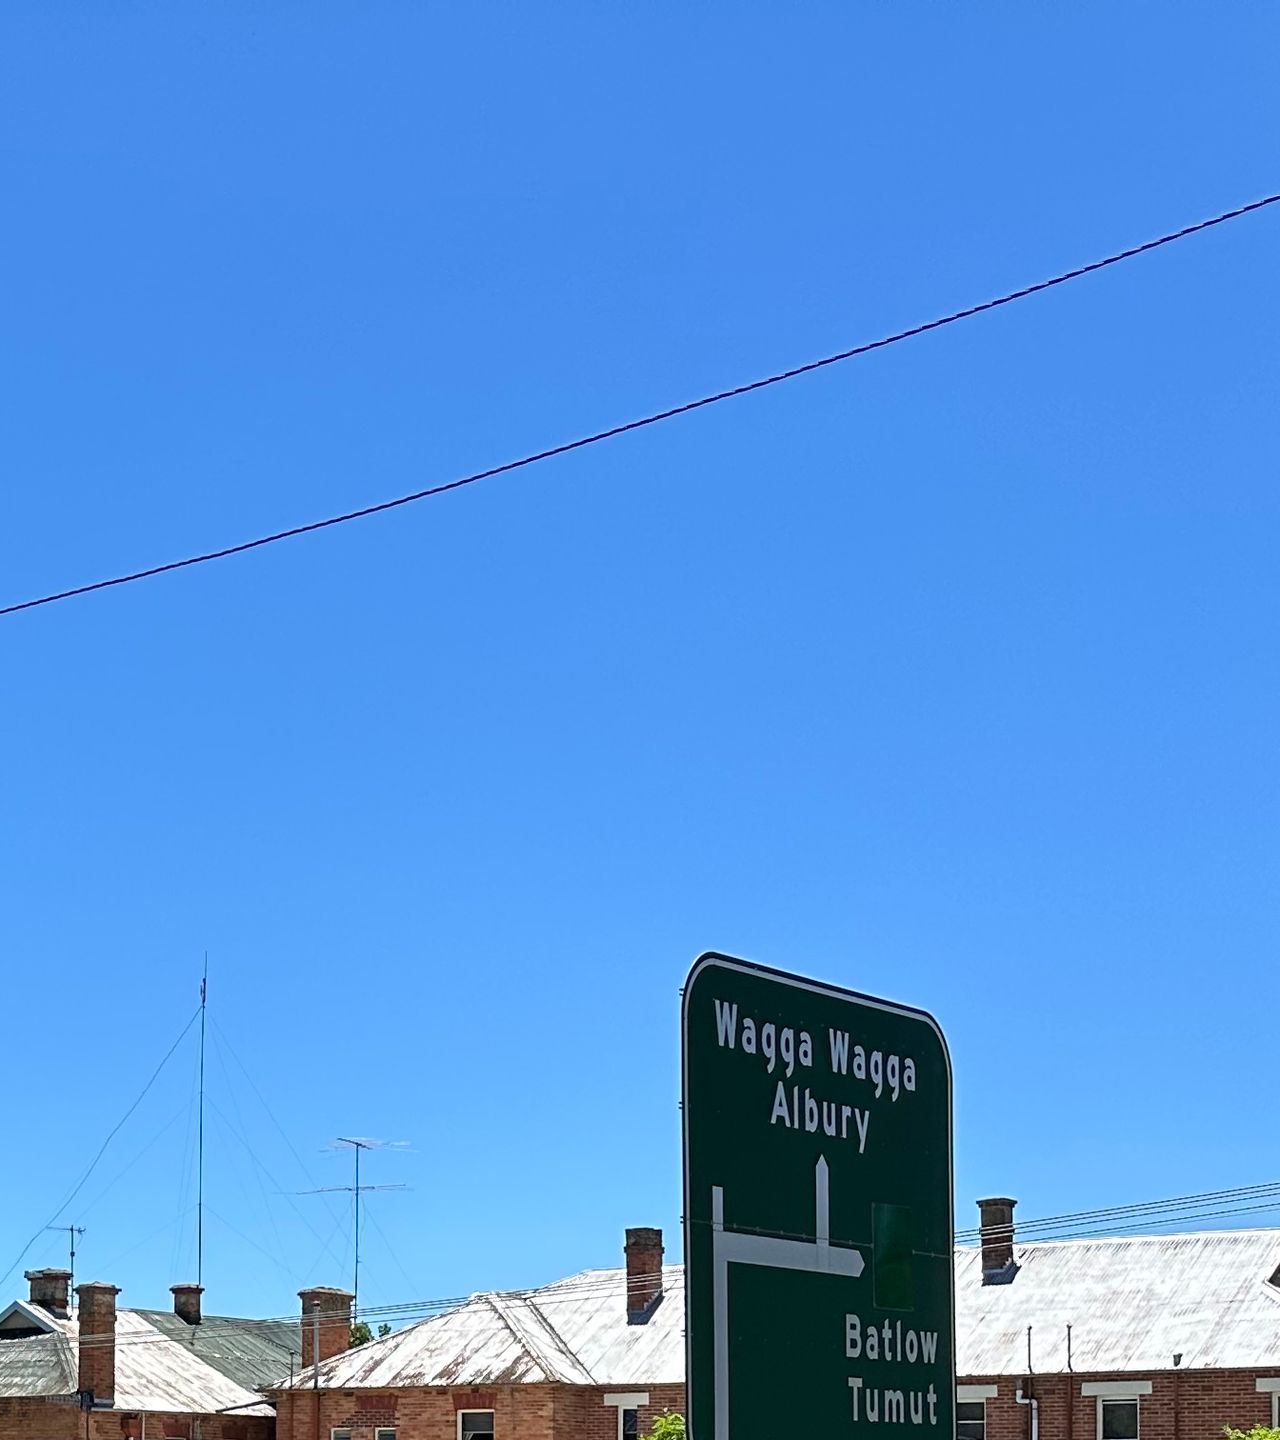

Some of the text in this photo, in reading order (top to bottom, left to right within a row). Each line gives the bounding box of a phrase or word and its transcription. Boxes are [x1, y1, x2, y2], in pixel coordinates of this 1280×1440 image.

[712, 998, 917, 1103] Wagga Wagga
[769, 1080, 871, 1154] Albury
[845, 1313, 939, 1365] Batlow
[847, 1377, 938, 1426] Tumut
